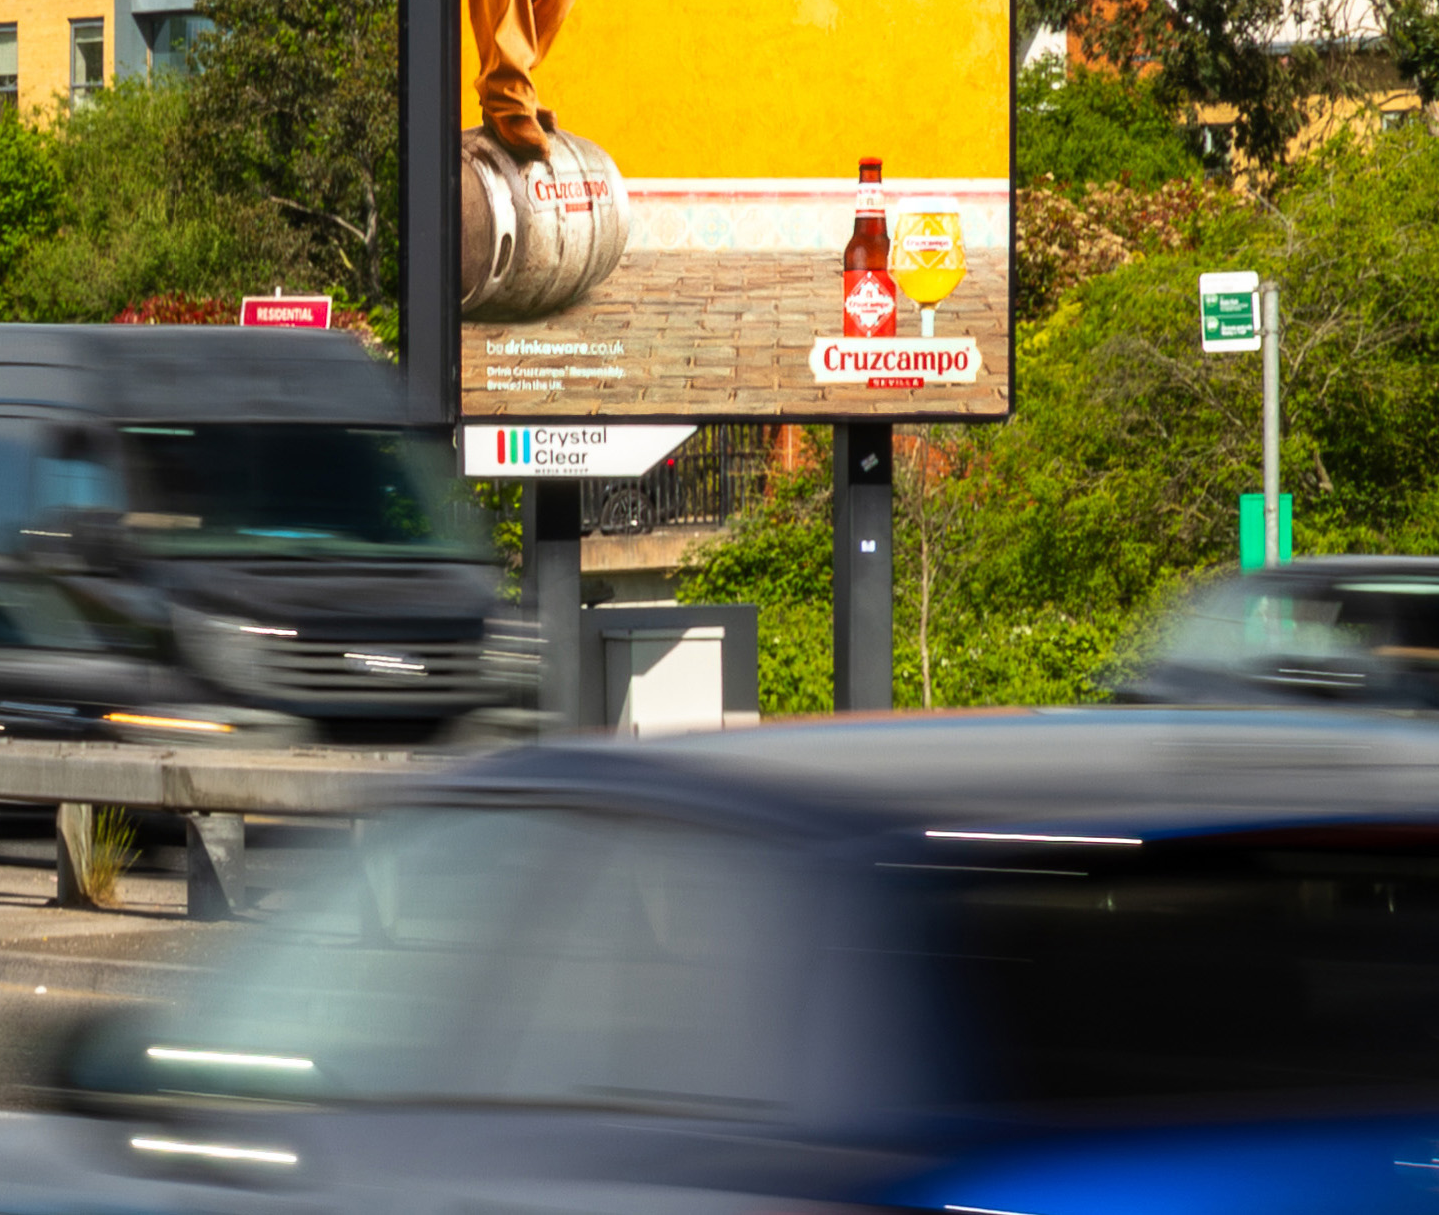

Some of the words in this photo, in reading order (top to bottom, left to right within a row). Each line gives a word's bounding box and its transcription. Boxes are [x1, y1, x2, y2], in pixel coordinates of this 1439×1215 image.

[256, 308, 313, 321] RESIDENTIAL
[535, 426, 607, 447] Crystal
[535, 449, 588, 465] Clear
